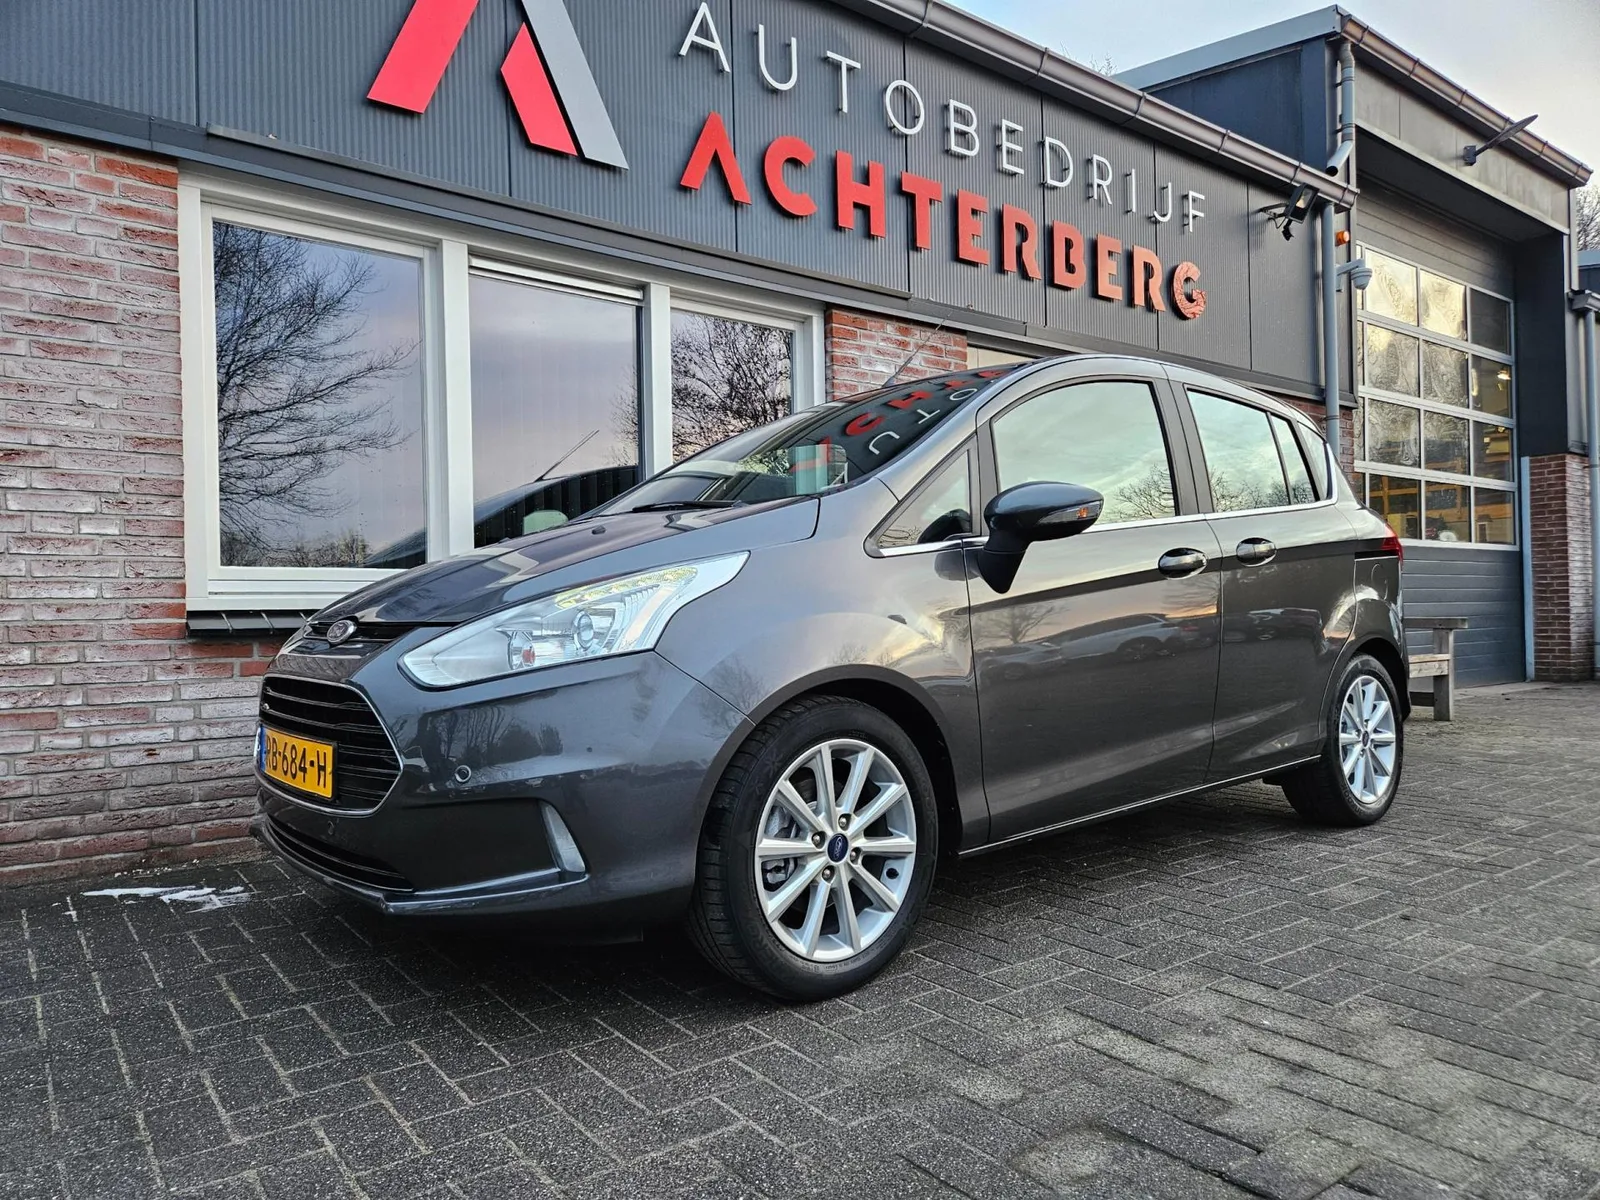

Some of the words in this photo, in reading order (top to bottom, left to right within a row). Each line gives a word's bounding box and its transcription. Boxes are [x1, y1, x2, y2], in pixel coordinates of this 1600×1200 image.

[678, 1, 1206, 232] AUTOBEDRIJF
[680, 110, 1207, 320] ACHTERBERG
[266, 734, 327, 789] RB-684-H
